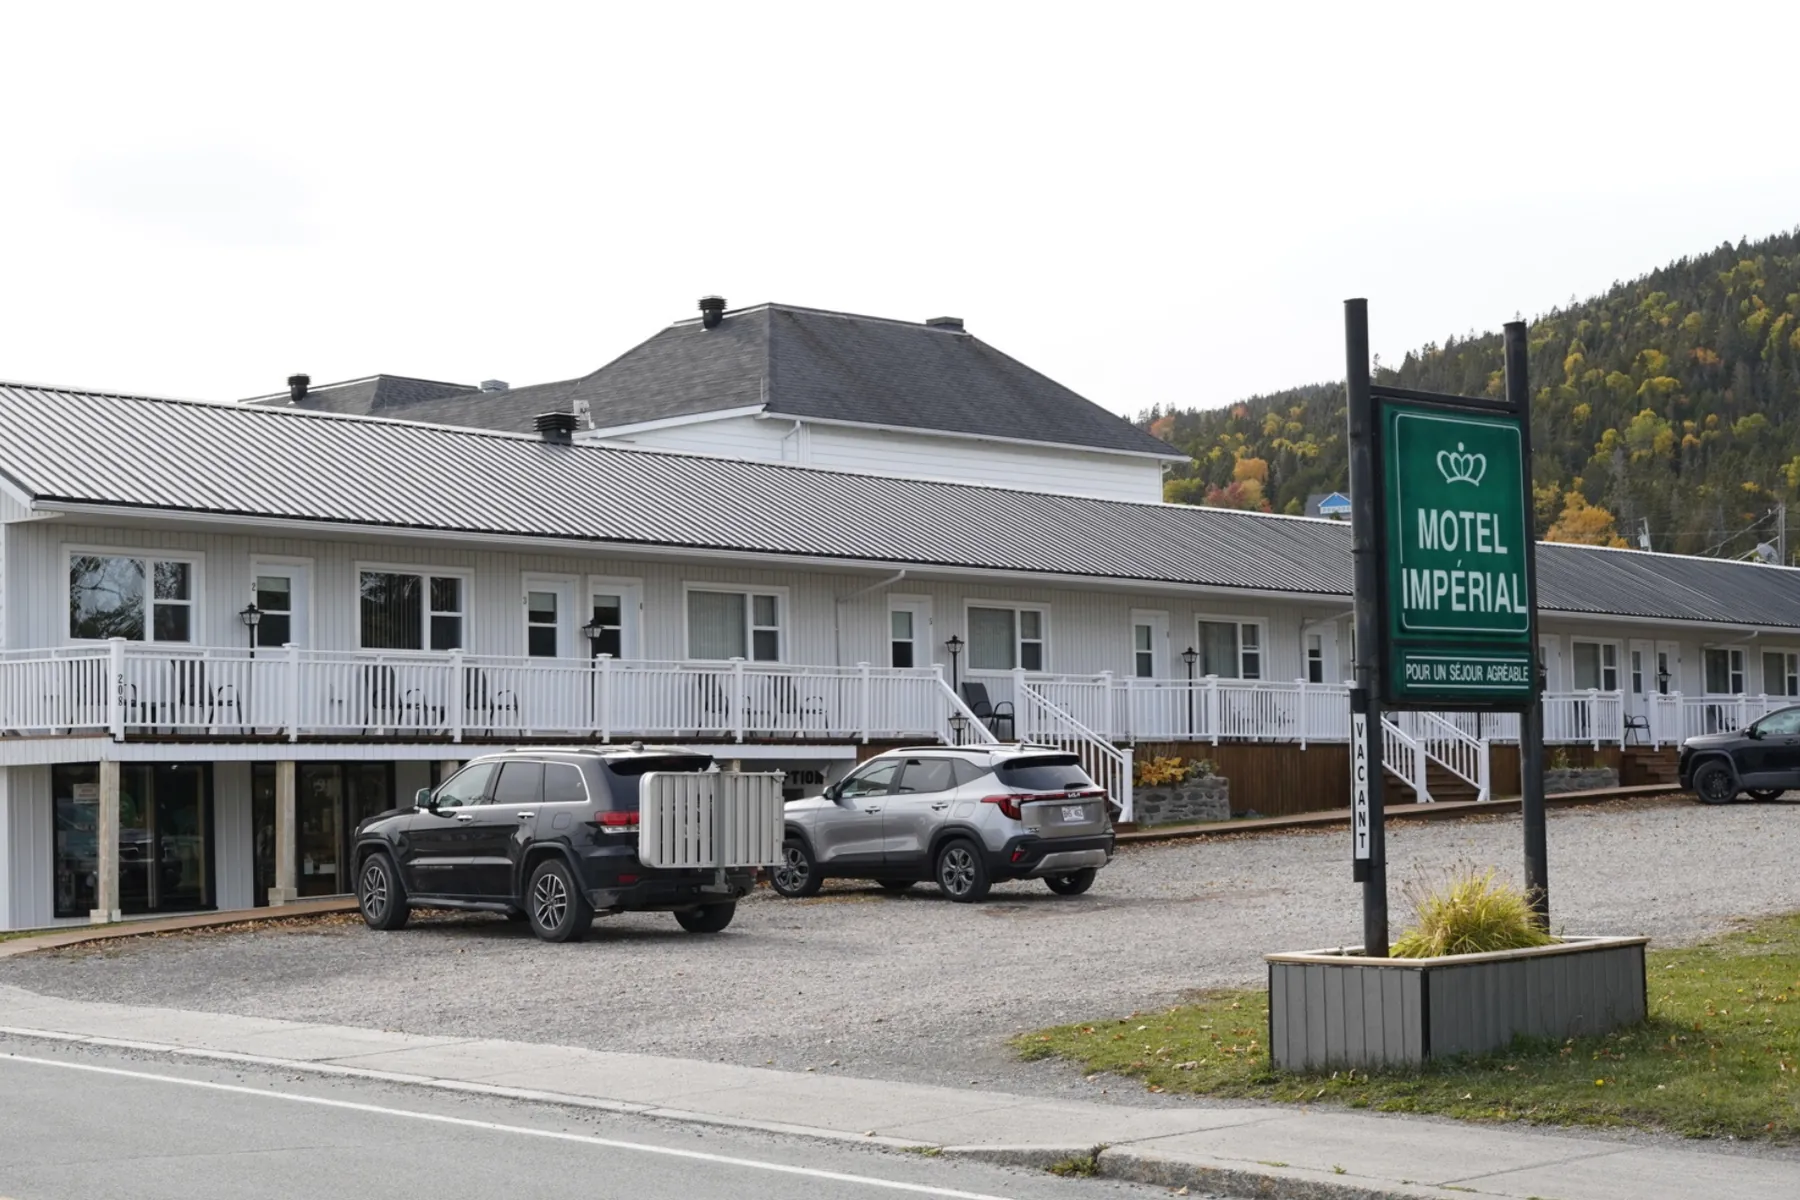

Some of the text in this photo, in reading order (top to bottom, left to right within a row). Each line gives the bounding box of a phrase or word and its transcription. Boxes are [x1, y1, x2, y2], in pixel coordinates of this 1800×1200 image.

[1417, 508, 1508, 554] MOTEL
[251, 582, 256, 592] 2
[1402, 560, 1527, 613] IMPÉRIAL
[1405, 661, 1529, 682] POUR UN SÉJOUR AGRÉABLE
[783, 770, 824, 785] TION
[1356, 722, 1367, 849] VACANT
